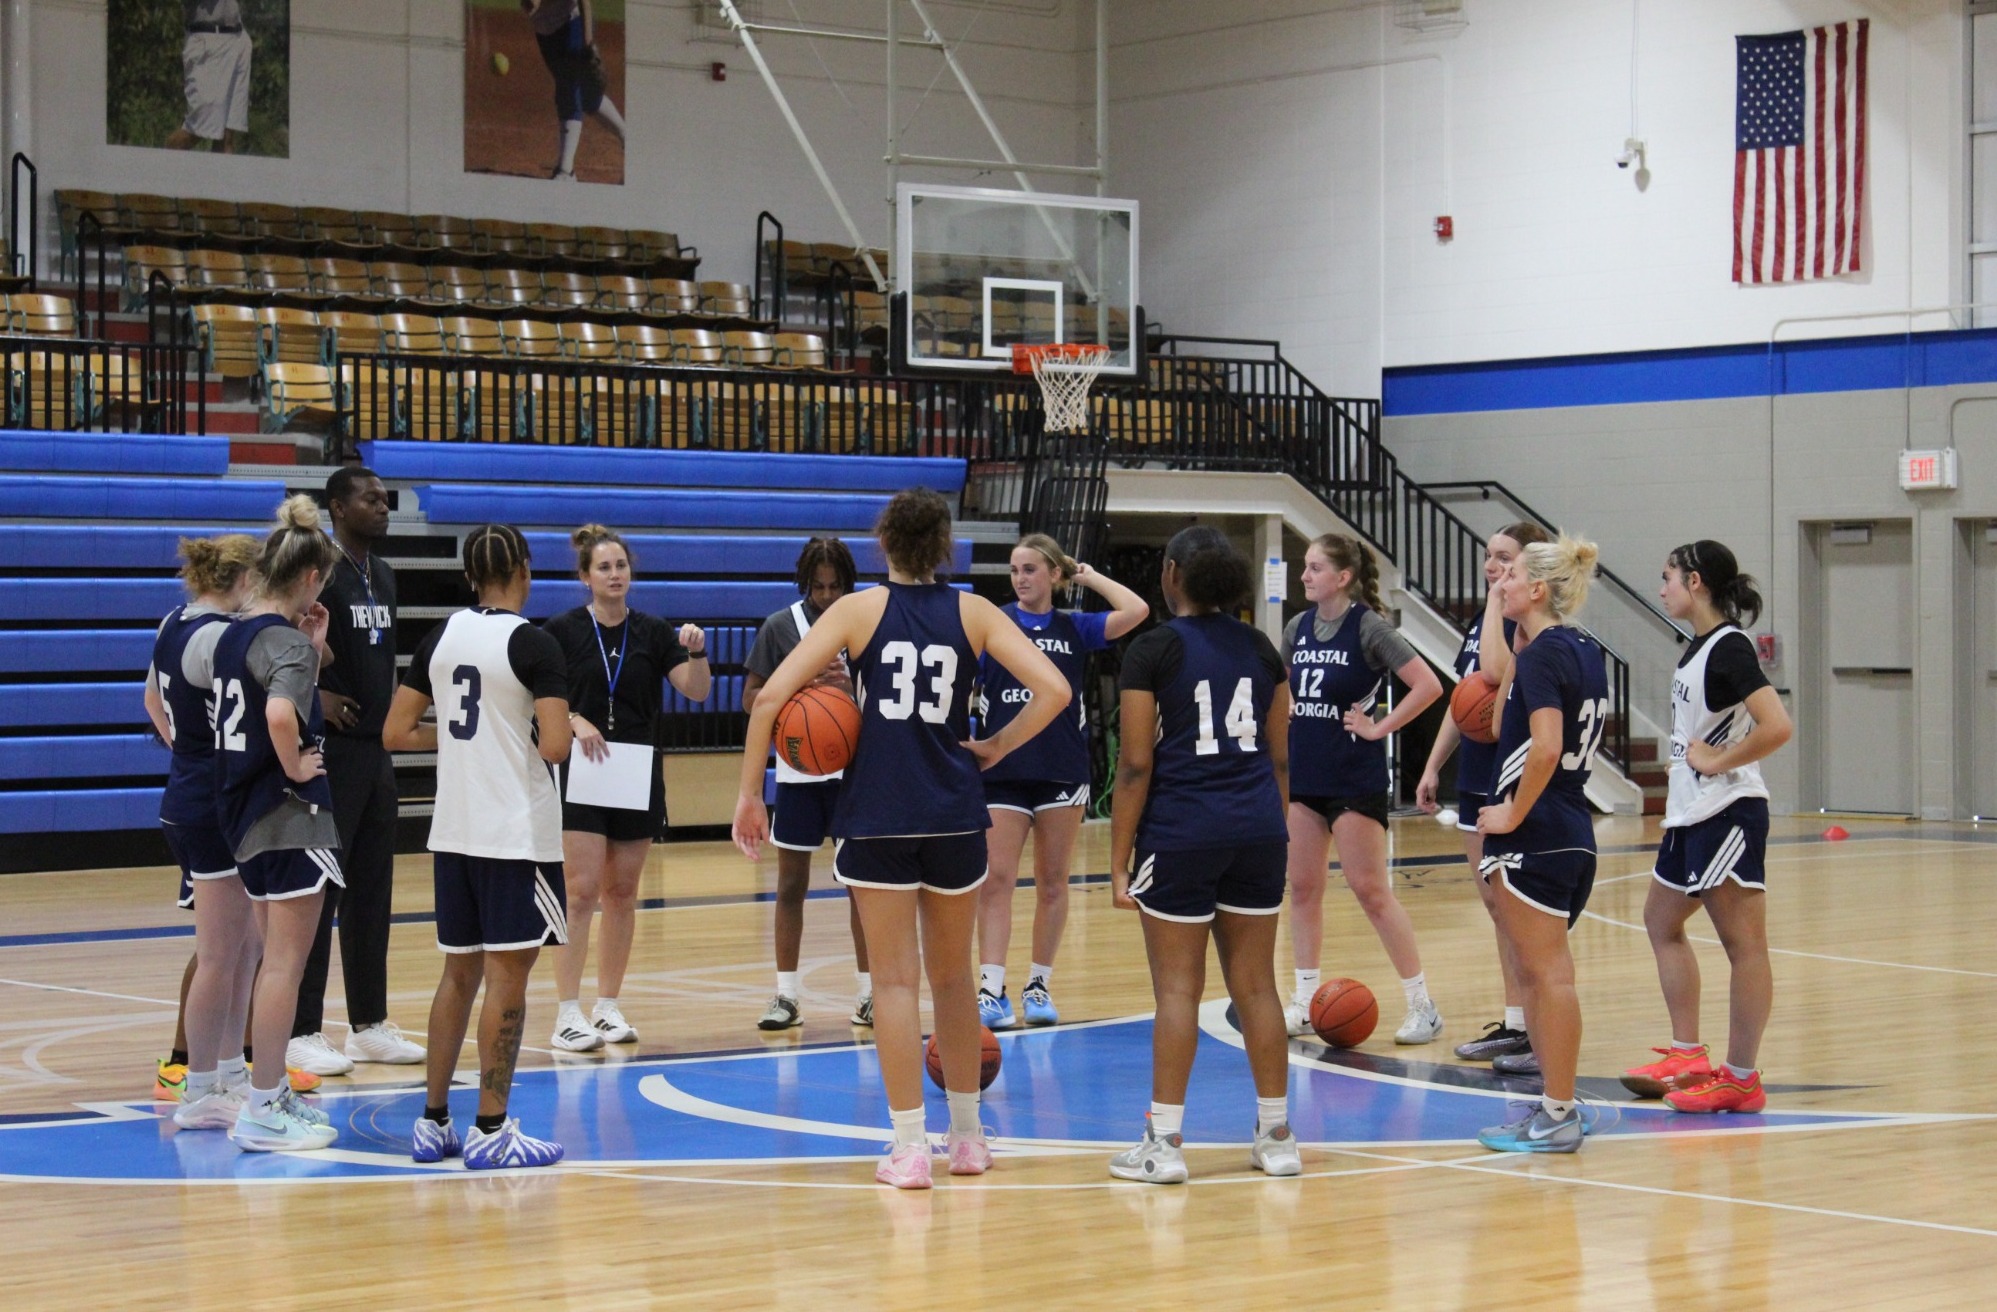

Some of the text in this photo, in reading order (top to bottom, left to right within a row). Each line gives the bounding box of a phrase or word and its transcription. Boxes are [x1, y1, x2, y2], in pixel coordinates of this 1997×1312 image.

[1910, 457, 1934, 481] EXIT
[1028, 638, 1073, 655] STAL
[1292, 649, 1350, 666] COASTAL
[878, 640, 958, 725] 33
[1298, 667, 1325, 698] 12
[1672, 679, 1690, 703] STAL
[158, 671, 177, 741] 5
[448, 664, 482, 740] 3
[1194, 677, 1259, 756] 14
[1294, 702, 1340, 720] ORGIA
[1561, 698, 1608, 772] 32
